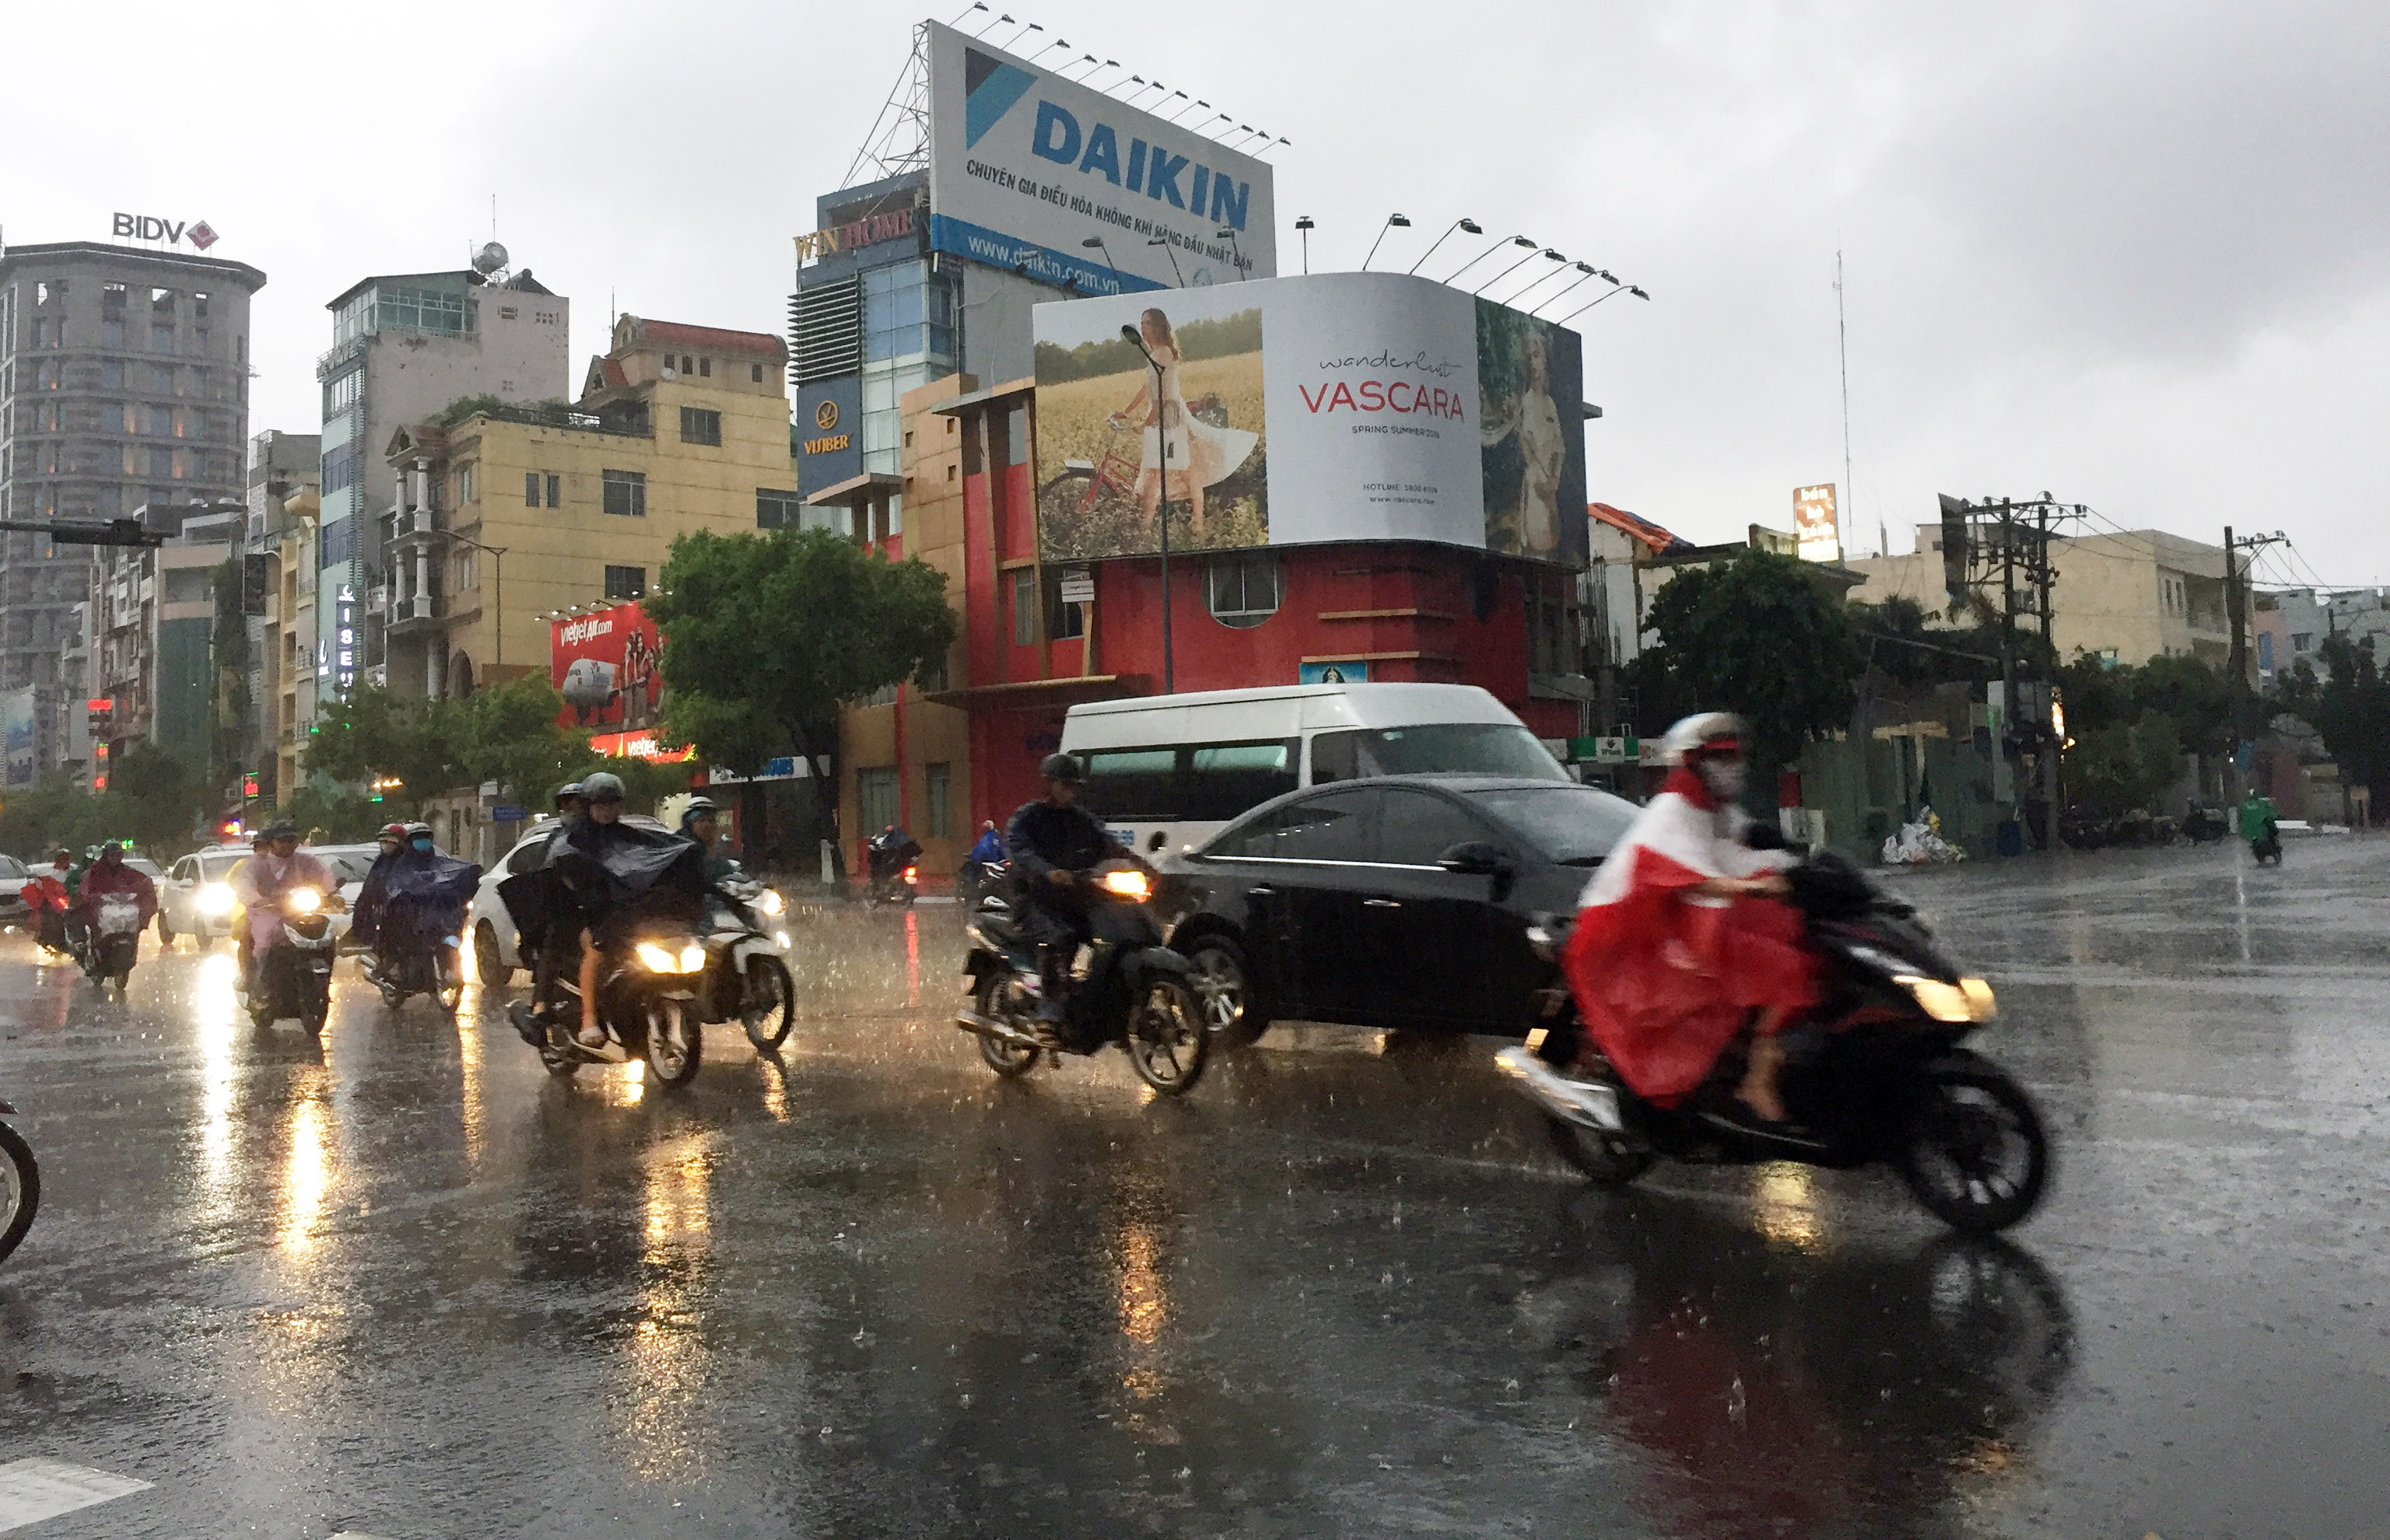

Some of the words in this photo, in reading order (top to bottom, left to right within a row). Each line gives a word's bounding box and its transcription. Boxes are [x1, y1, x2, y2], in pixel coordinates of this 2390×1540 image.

[1032, 100, 1249, 232] DAIKIN
[966, 159, 1016, 190] CHUYÊN
[1018, 177, 1037, 198] GIA
[1040, 184, 1067, 208] ĐIỀU
[1070, 195, 1092, 217] HÒA
[1095, 205, 1132, 229] KHÔNG
[113, 212, 186, 244] BIDV
[1319, 349, 1463, 378] wanderlust
[1298, 380, 1465, 423] VASCARA
[1351, 425, 1389, 435] SPRING
[1390, 425, 1425, 436] SUMMER
[1363, 483, 1400, 492] HOTLINE
[1800, 486, 1829, 502] bún
